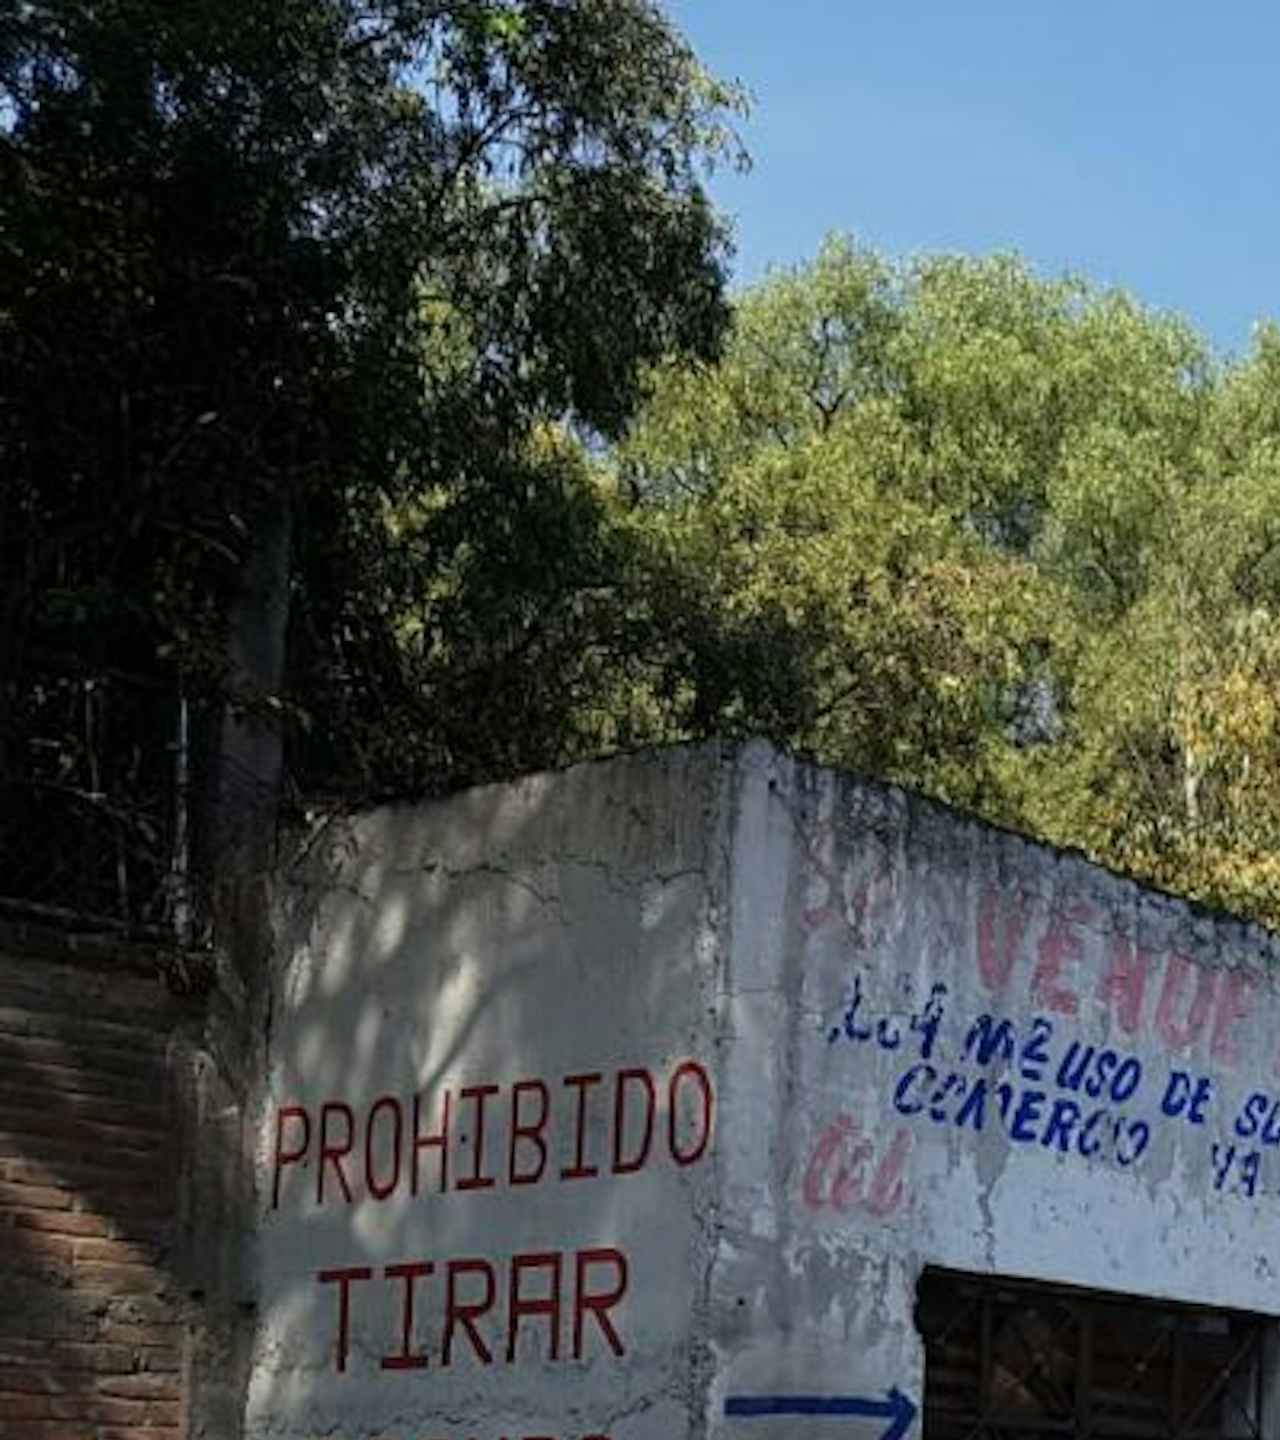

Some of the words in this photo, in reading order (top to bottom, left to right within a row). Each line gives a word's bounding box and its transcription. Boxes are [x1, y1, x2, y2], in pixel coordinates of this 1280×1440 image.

[272, 1061, 712, 1210] PROHIBIDO
[1055, 1041, 1143, 1103] USO
[1160, 1071, 1212, 1125] DE
[317, 1248, 629, 1373] TIRAR
